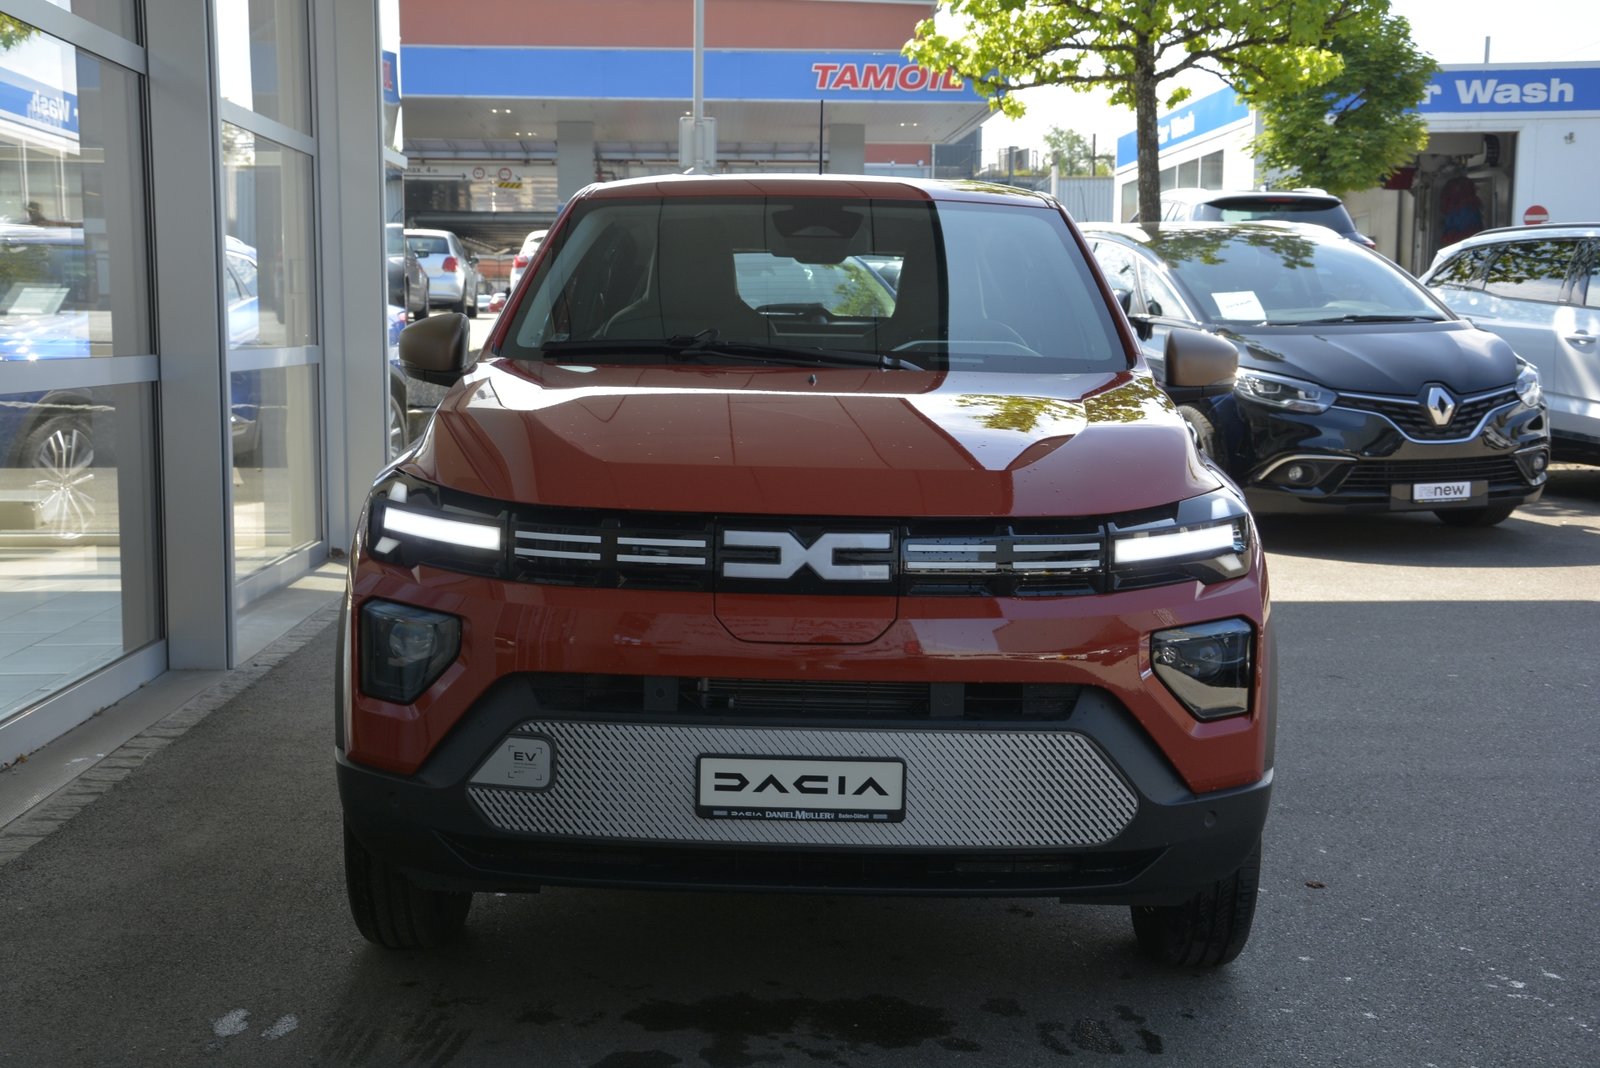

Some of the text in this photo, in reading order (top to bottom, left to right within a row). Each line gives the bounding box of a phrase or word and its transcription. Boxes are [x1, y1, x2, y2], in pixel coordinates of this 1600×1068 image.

[812, 63, 965, 92] TAMOIL
[1455, 78, 1574, 104] Wash
[514, 752, 537, 761] EV
[714, 772, 889, 796] DACIA
